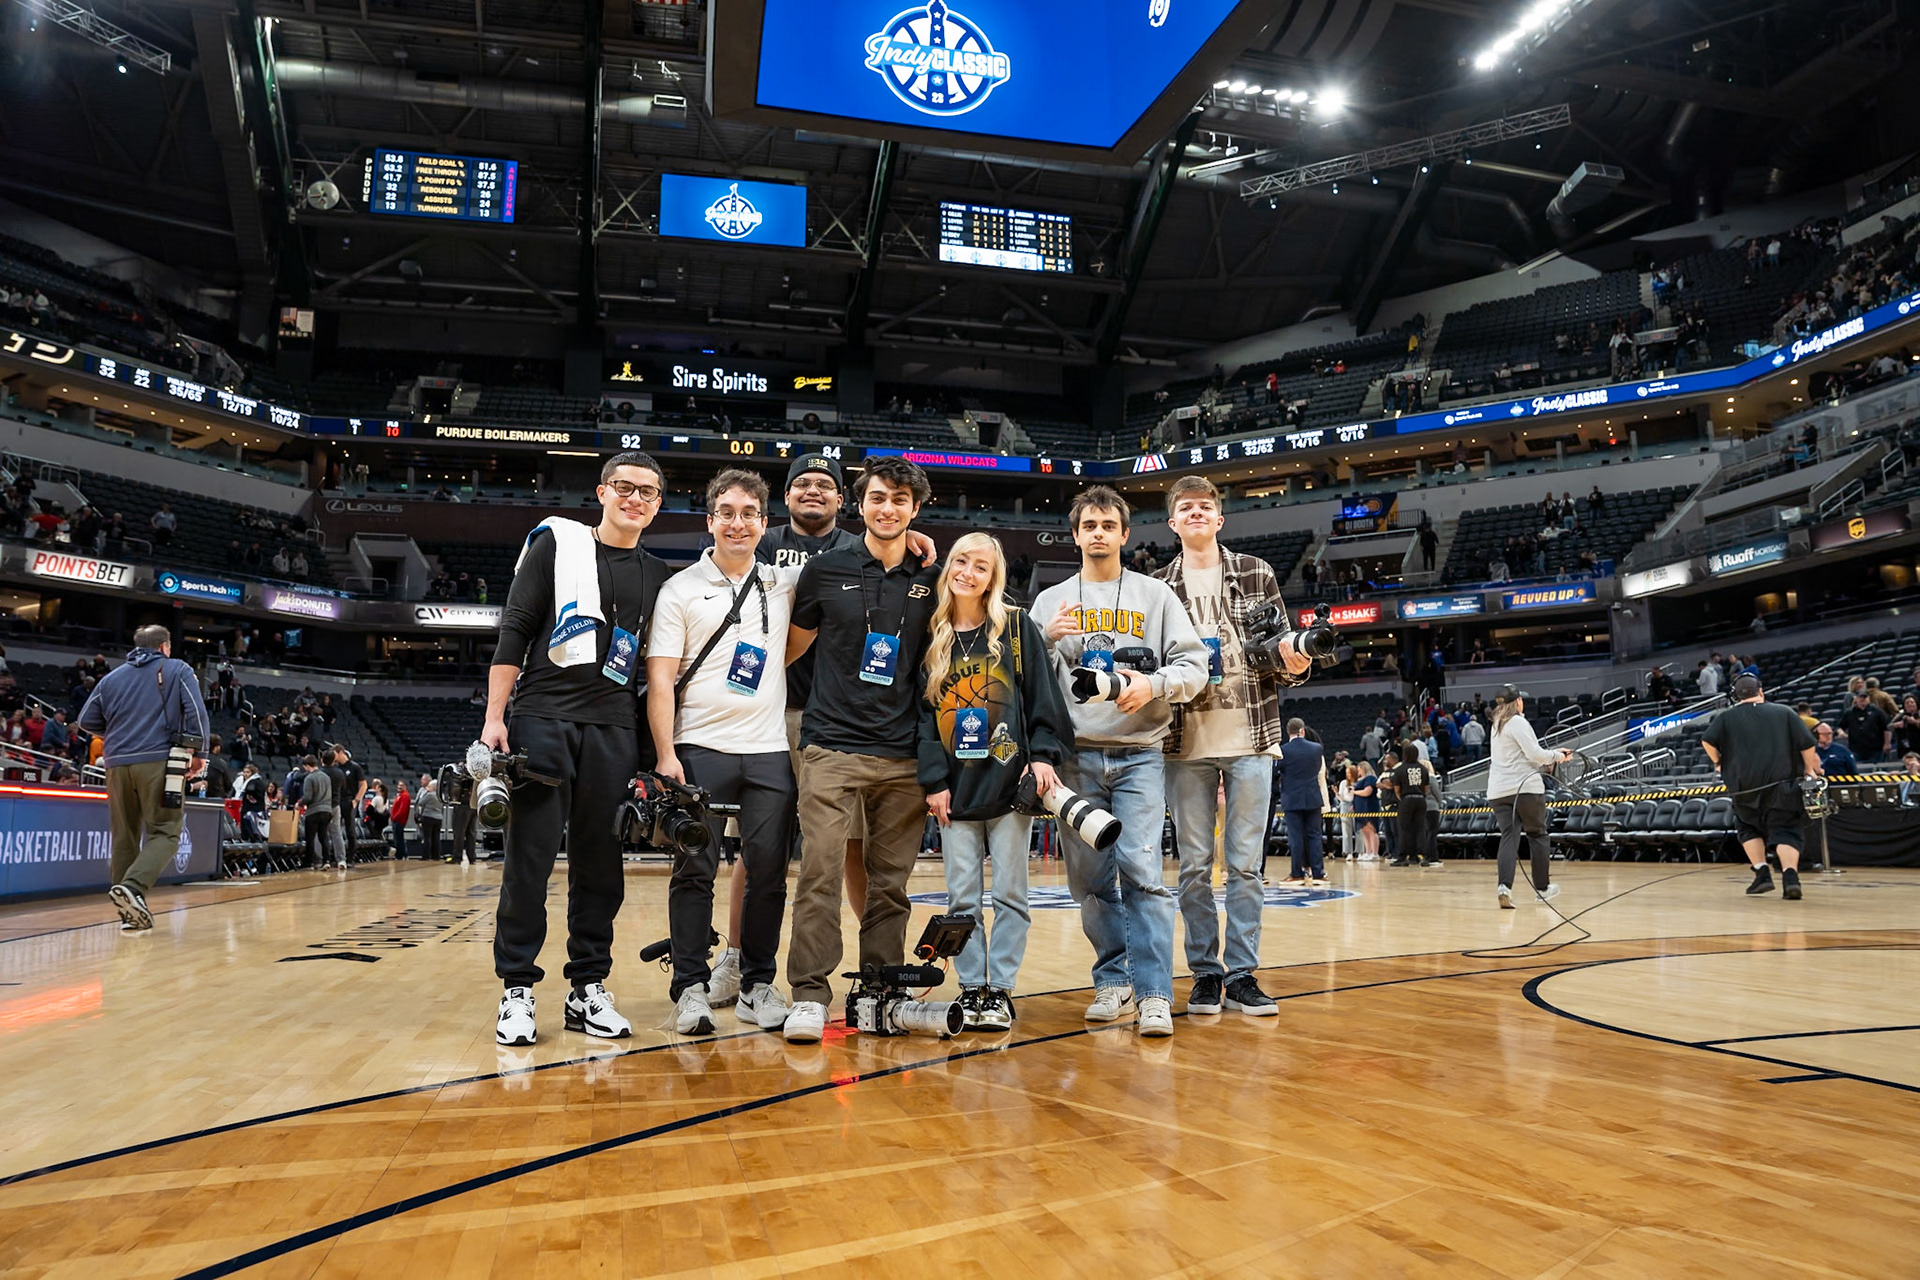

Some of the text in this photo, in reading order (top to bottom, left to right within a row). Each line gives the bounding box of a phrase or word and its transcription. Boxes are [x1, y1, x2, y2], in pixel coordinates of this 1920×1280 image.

[383, 163, 403, 173] 63.2
[479, 162, 497, 171] 51.6
[362, 157, 373, 202] PURDUE
[383, 173, 402, 182] 41.7
[477, 181, 495, 189] 37.5
[386, 183, 491, 199] 32 REBOUNDS 26
[505, 167, 515, 217] ARIZONA
[385, 192, 491, 208] 22 ASSISTS 24
[385, 201, 490, 217] 13 TURNOVERS 13
[99, 365, 116, 378] 32
[134, 374, 150, 388] 22
[672, 365, 767, 394] Sire Spirits
[169, 384, 203, 402] 35/65
[222, 399, 252, 415] 12/19
[271, 412, 299, 429] 10/24
[352, 425, 358, 435] 1
[387, 427, 400, 437] 10
[436, 426, 570, 443] PURDUE BOILERMAKERS
[1340, 430, 1365, 442] 6/16
[621, 434, 641, 449] 92
[730, 441, 754, 455] 0.0
[1291, 436, 1320, 449] 14/16
[780, 448, 788, 458] 2
[822, 446, 842, 460] 84
[1217, 450, 1229, 460] 24
[1245, 443, 1273, 456] 32/62
[902, 452, 997, 467] ARIZONA WILDCATS
[1190, 453, 1203, 464] 26
[1040, 464, 1053, 473] 10
[1074, 466, 1080, 475] 0
[347, 502, 404, 513] LEXUS
[1723, 541, 1788, 568] Ruoff MORTGAGE
[32, 552, 129, 583] POINTSBET
[181, 580, 241, 596] Sports Tech HQ
[1512, 588, 1574, 606] REVVED UP
[1341, 607, 1378, 620] SHAKE
